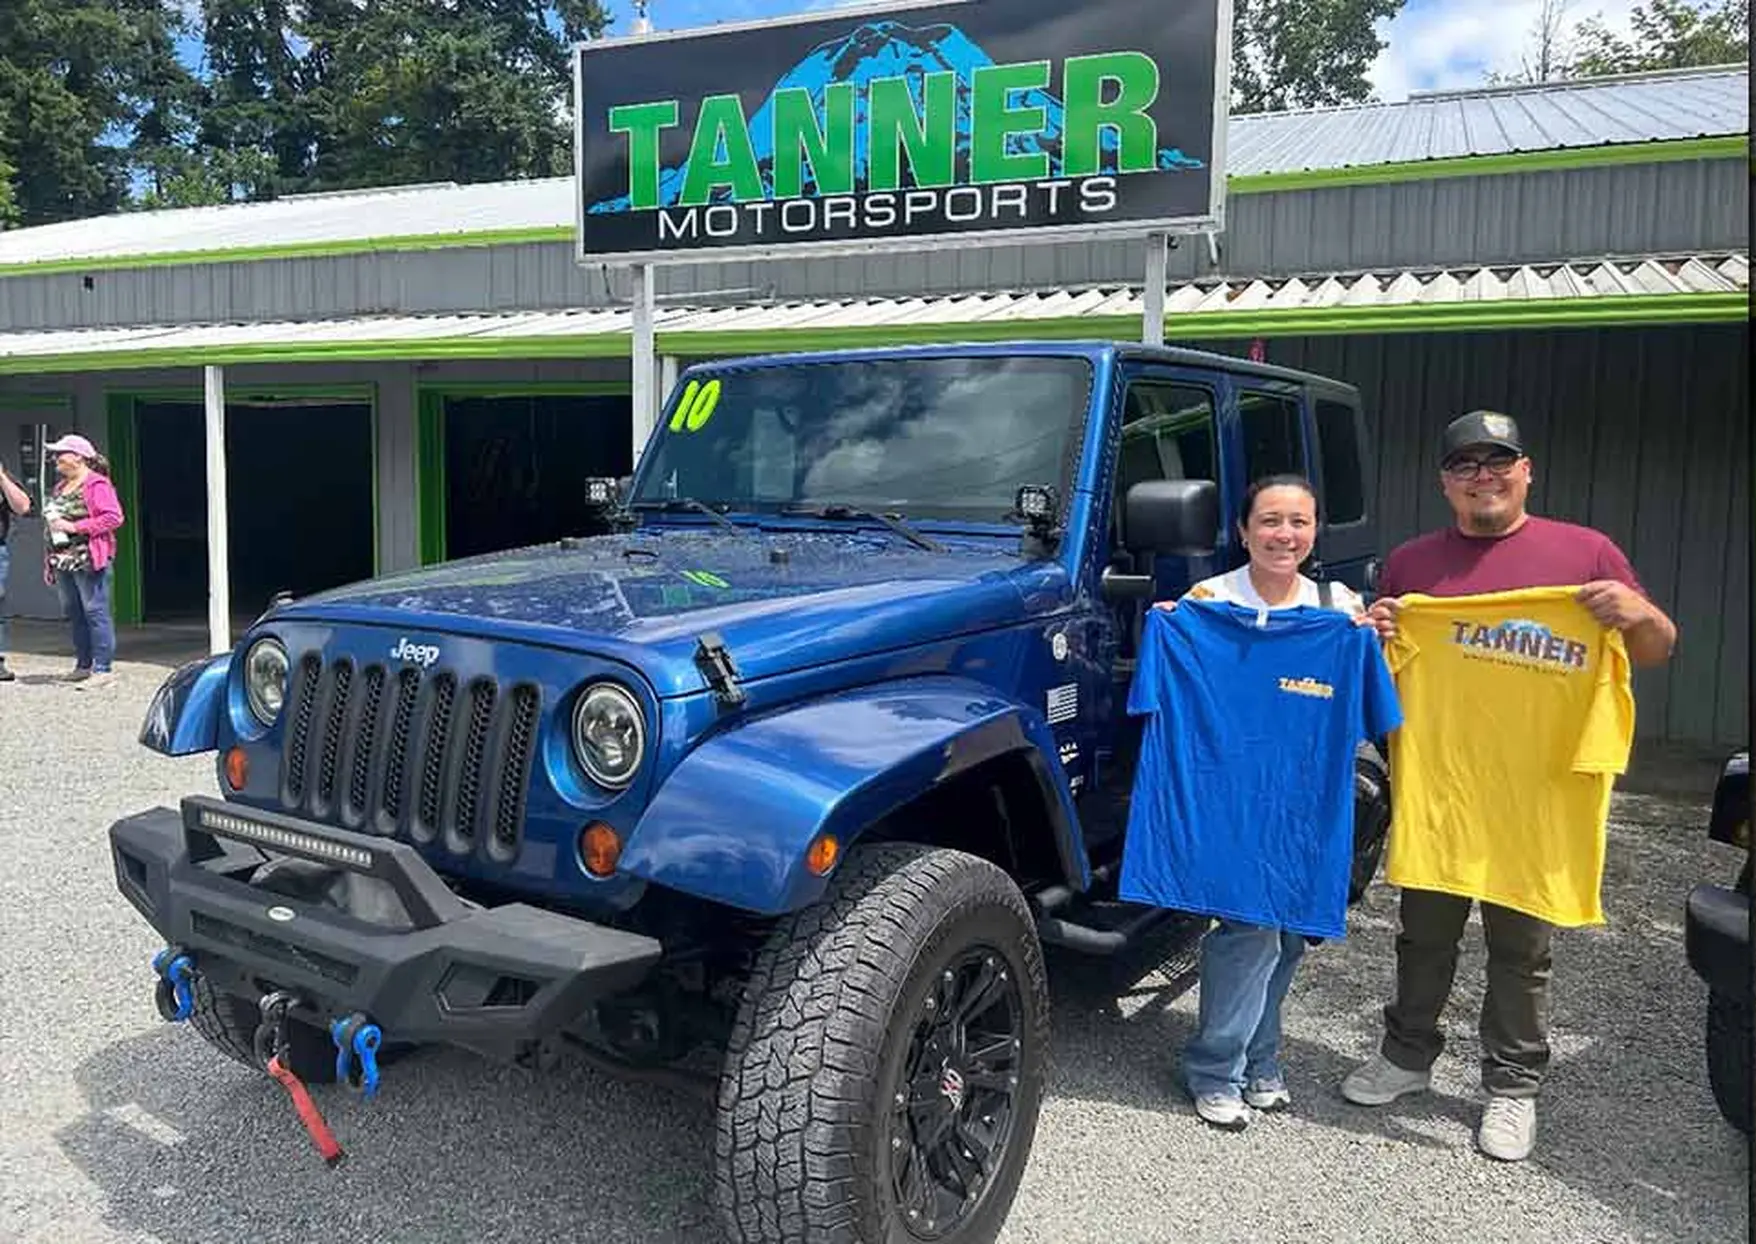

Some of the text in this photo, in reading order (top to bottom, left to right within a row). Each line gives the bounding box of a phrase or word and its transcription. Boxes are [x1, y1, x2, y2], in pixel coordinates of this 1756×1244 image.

[609, 51, 1160, 211] TANNER
[658, 178, 1118, 241] MOTORSPORTS
[669, 379, 721, 432] 10
[390, 637, 440, 668] Jeep
[1452, 620, 1588, 669] TANNER
